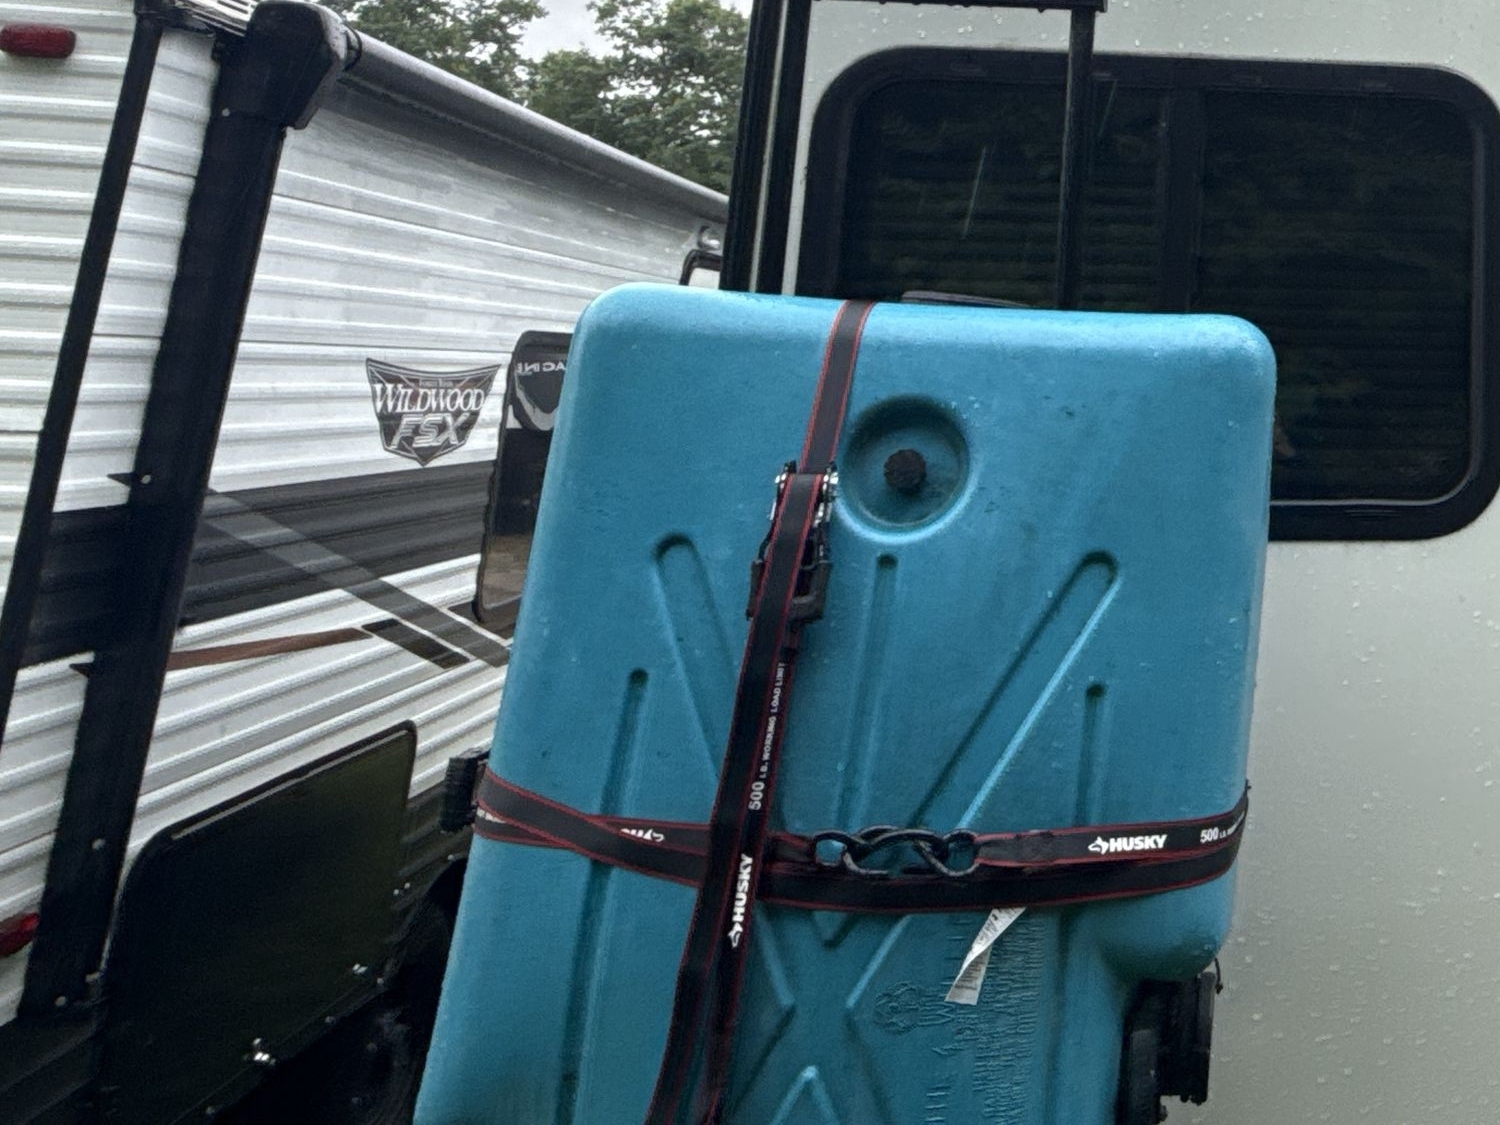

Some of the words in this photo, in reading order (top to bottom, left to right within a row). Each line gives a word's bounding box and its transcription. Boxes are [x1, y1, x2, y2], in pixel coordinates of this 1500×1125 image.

[374, 383, 484, 413] WILDWOOD
[391, 413, 469, 449] FSX
[749, 781, 765, 811] 500
[771, 687, 781, 712] LOAD
[1109, 835, 1167, 852] HUSKY
[1200, 827, 1219, 844] 500
[732, 854, 753, 922] HUSKY
